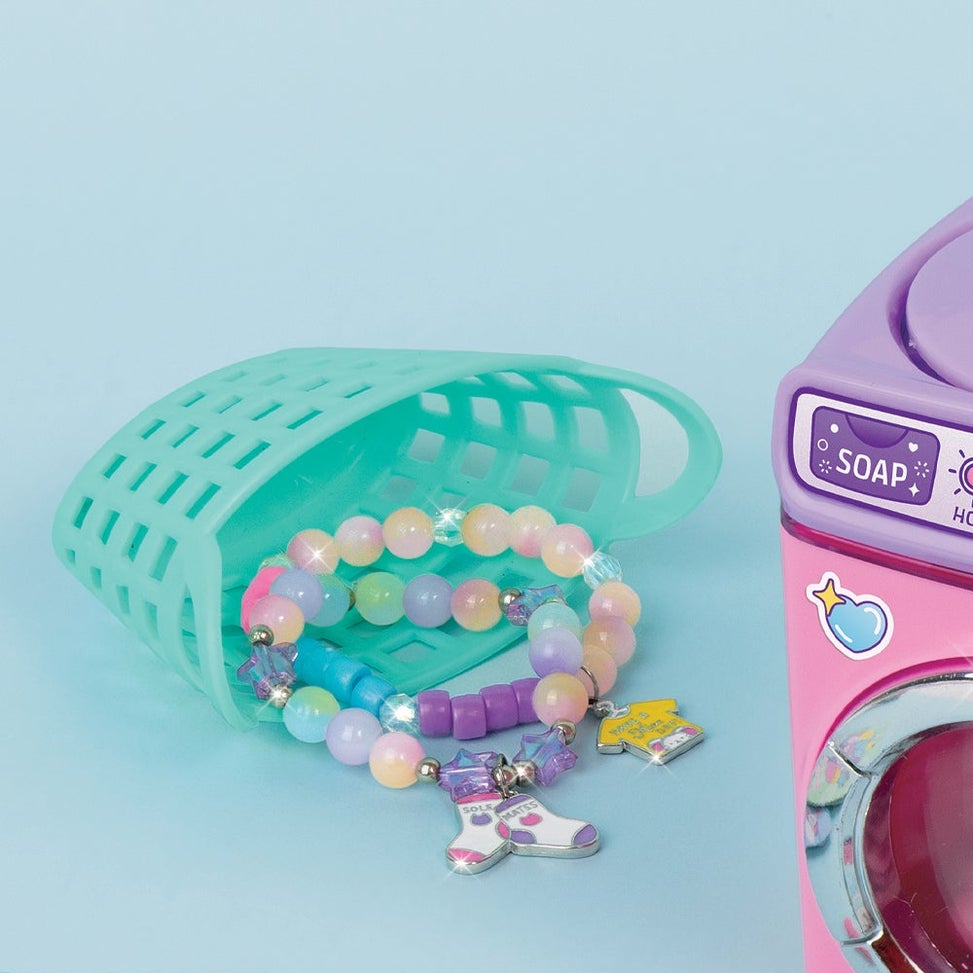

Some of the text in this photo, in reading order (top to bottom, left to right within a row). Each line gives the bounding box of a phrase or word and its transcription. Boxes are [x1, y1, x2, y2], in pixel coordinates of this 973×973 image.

[834, 448, 909, 489] SOAP
[462, 801, 539, 820] SOLE MATES
